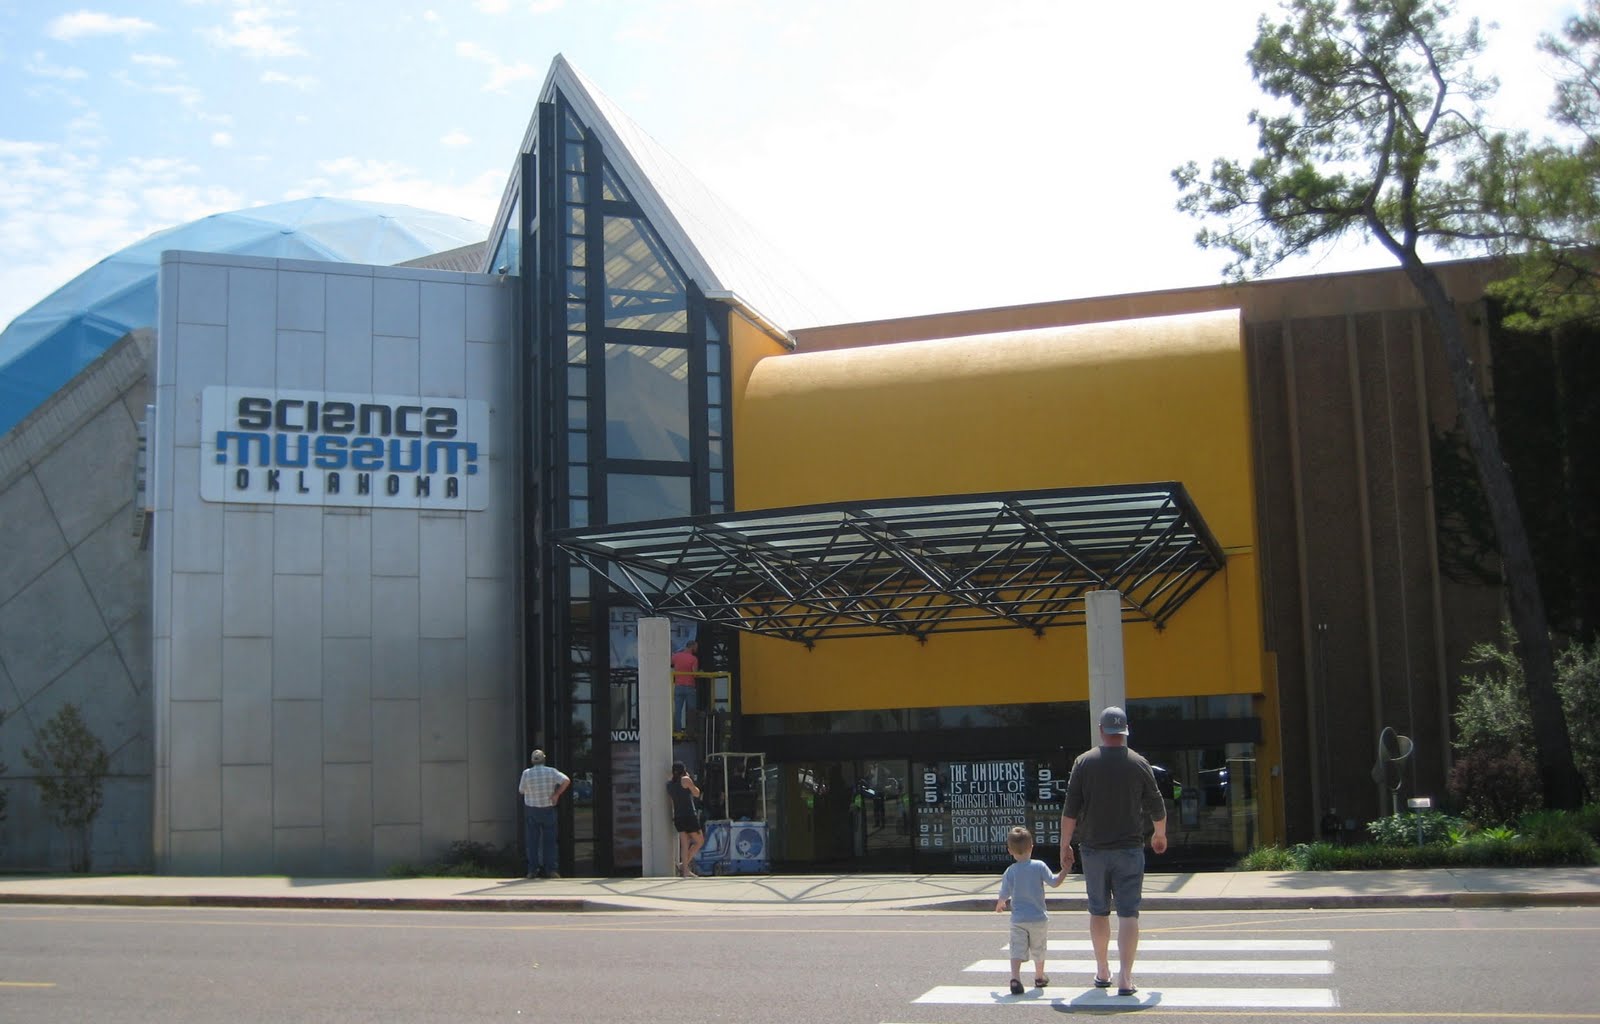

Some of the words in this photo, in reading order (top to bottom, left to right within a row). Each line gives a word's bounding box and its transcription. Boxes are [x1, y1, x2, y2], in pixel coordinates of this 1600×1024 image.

[236, 468, 459, 498] OKLAHOMA
[611, 731, 641, 741] NOW
[950, 764, 968, 781] THE
[972, 762, 1025, 781] UNIVERSE
[1038, 769, 1052, 780] 9
[924, 773, 937, 784] 9
[951, 782, 963, 794] IS
[970, 781, 1004, 794] FULL
[1007, 780, 1026, 793] OF
[925, 791, 938, 803] 5
[1039, 788, 1052, 799] 5
[999, 792, 1026, 808] THINGS
[951, 809, 988, 817] PATIENTLY
[990, 808, 1025, 816] WAITING
[951, 817, 968, 826] FOR
[969, 816, 989, 826] OUR
[991, 816, 1013, 825] WITS
[1013, 815, 1026, 824] TO
[952, 826, 988, 844] GROW
